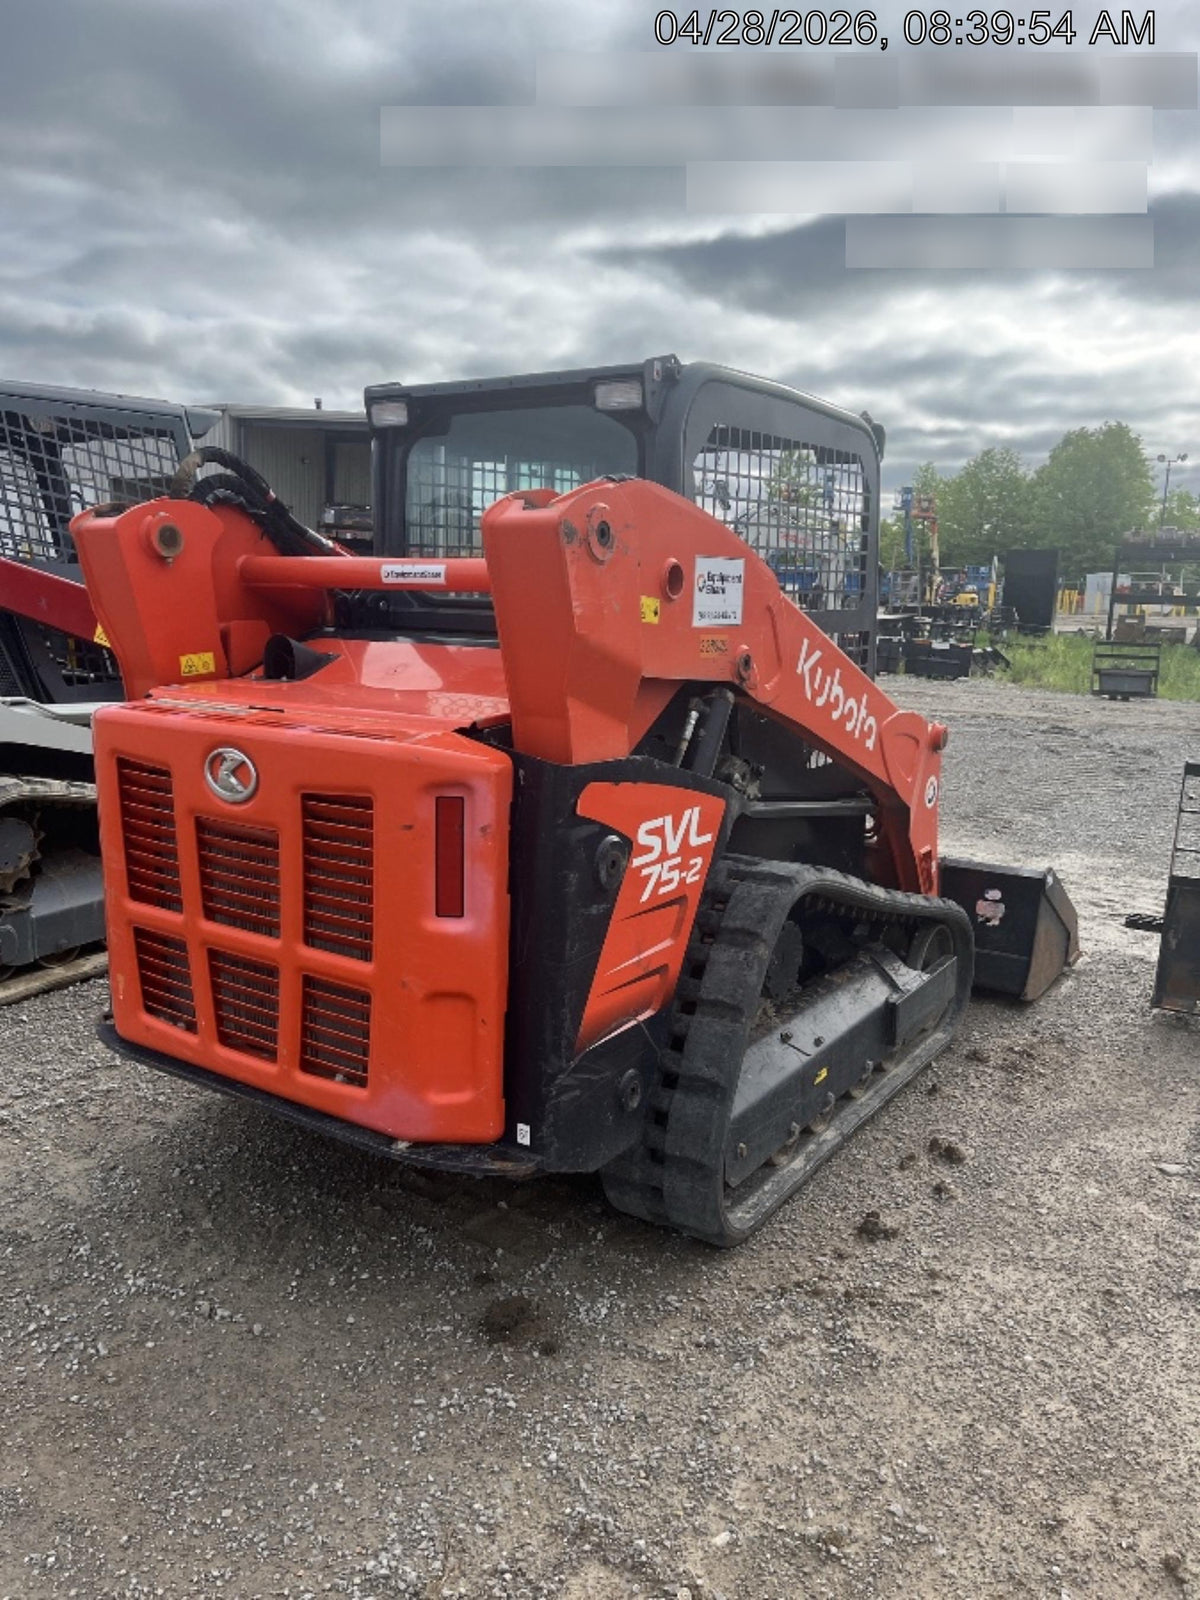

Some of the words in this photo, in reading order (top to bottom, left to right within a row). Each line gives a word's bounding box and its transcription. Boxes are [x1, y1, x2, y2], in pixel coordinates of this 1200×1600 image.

[796, 638, 877, 752] Kubota
[632, 807, 712, 868] SVL
[640, 857, 703, 903] 75-2
